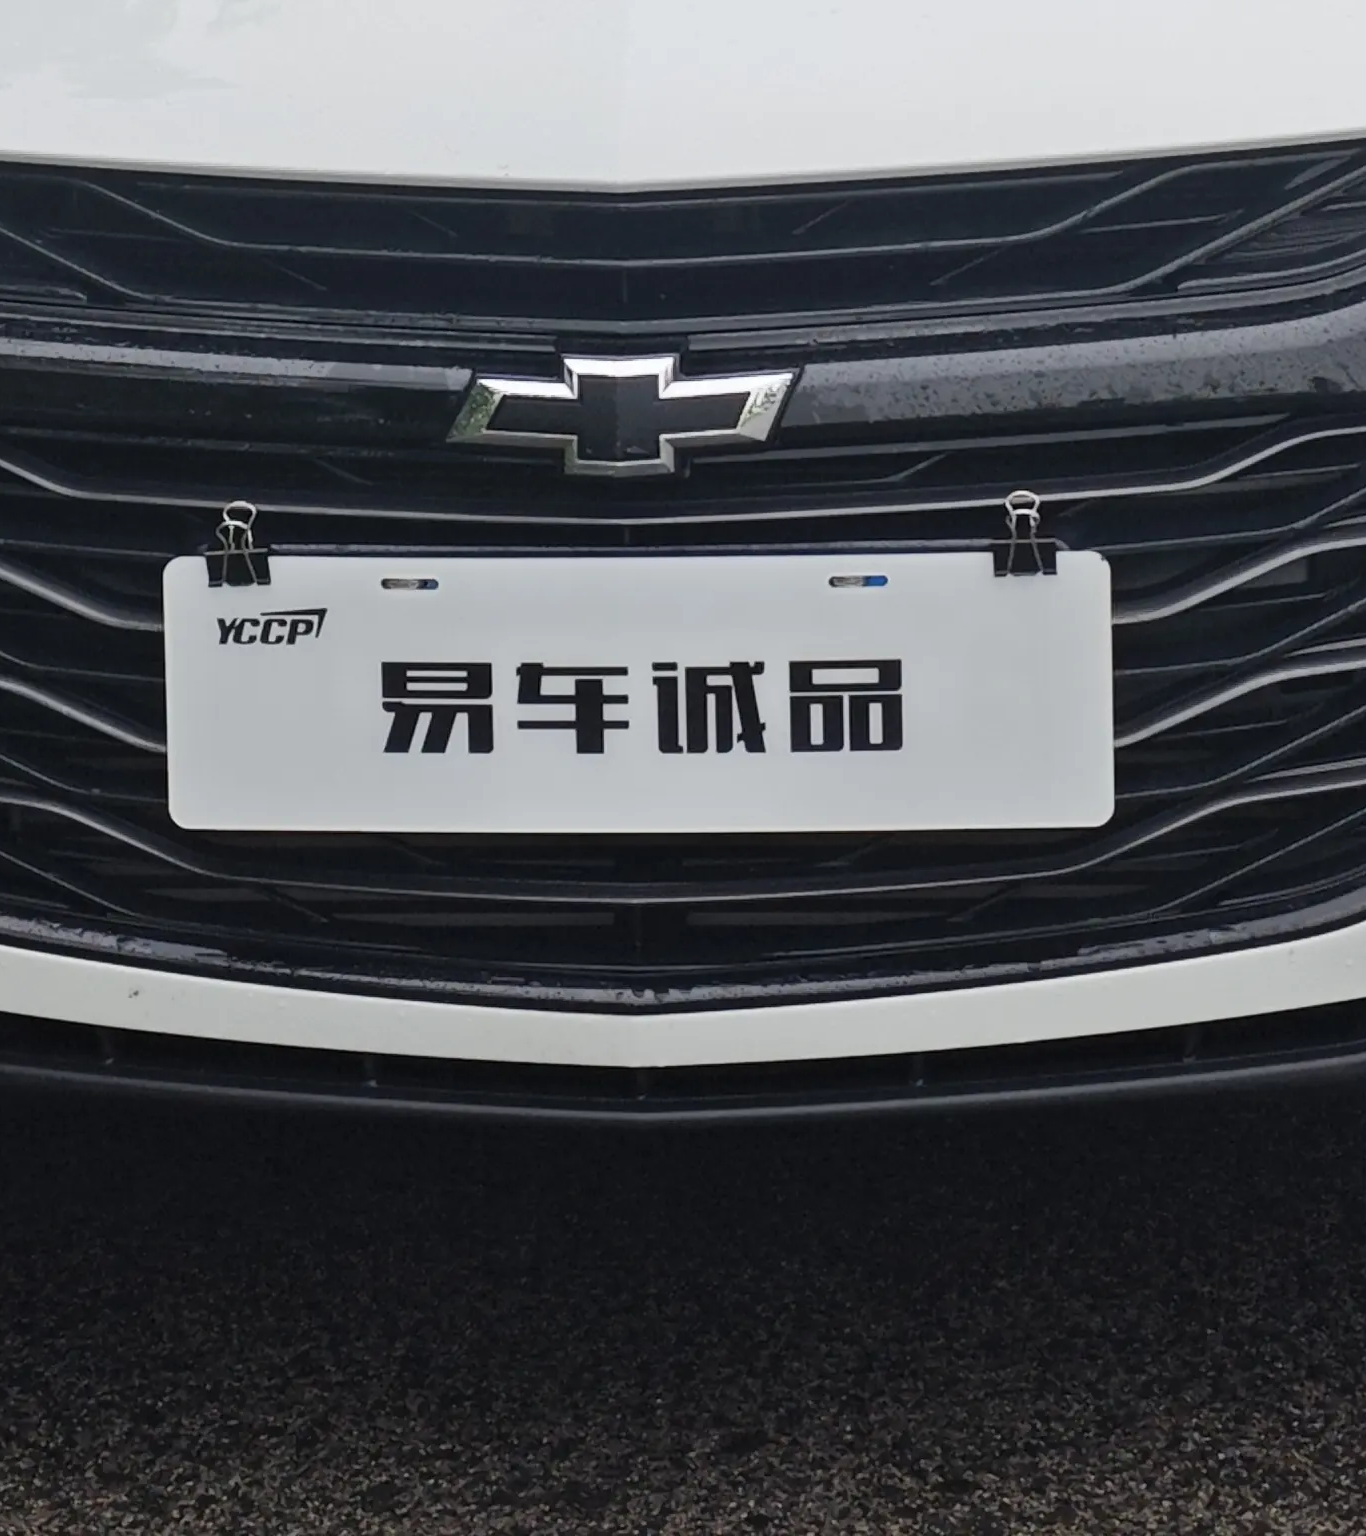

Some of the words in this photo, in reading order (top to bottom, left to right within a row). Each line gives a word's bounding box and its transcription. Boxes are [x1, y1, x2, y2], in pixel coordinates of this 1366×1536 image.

[216, 616, 315, 646] YCCP
[381, 659, 903, 754] 易车诚品
